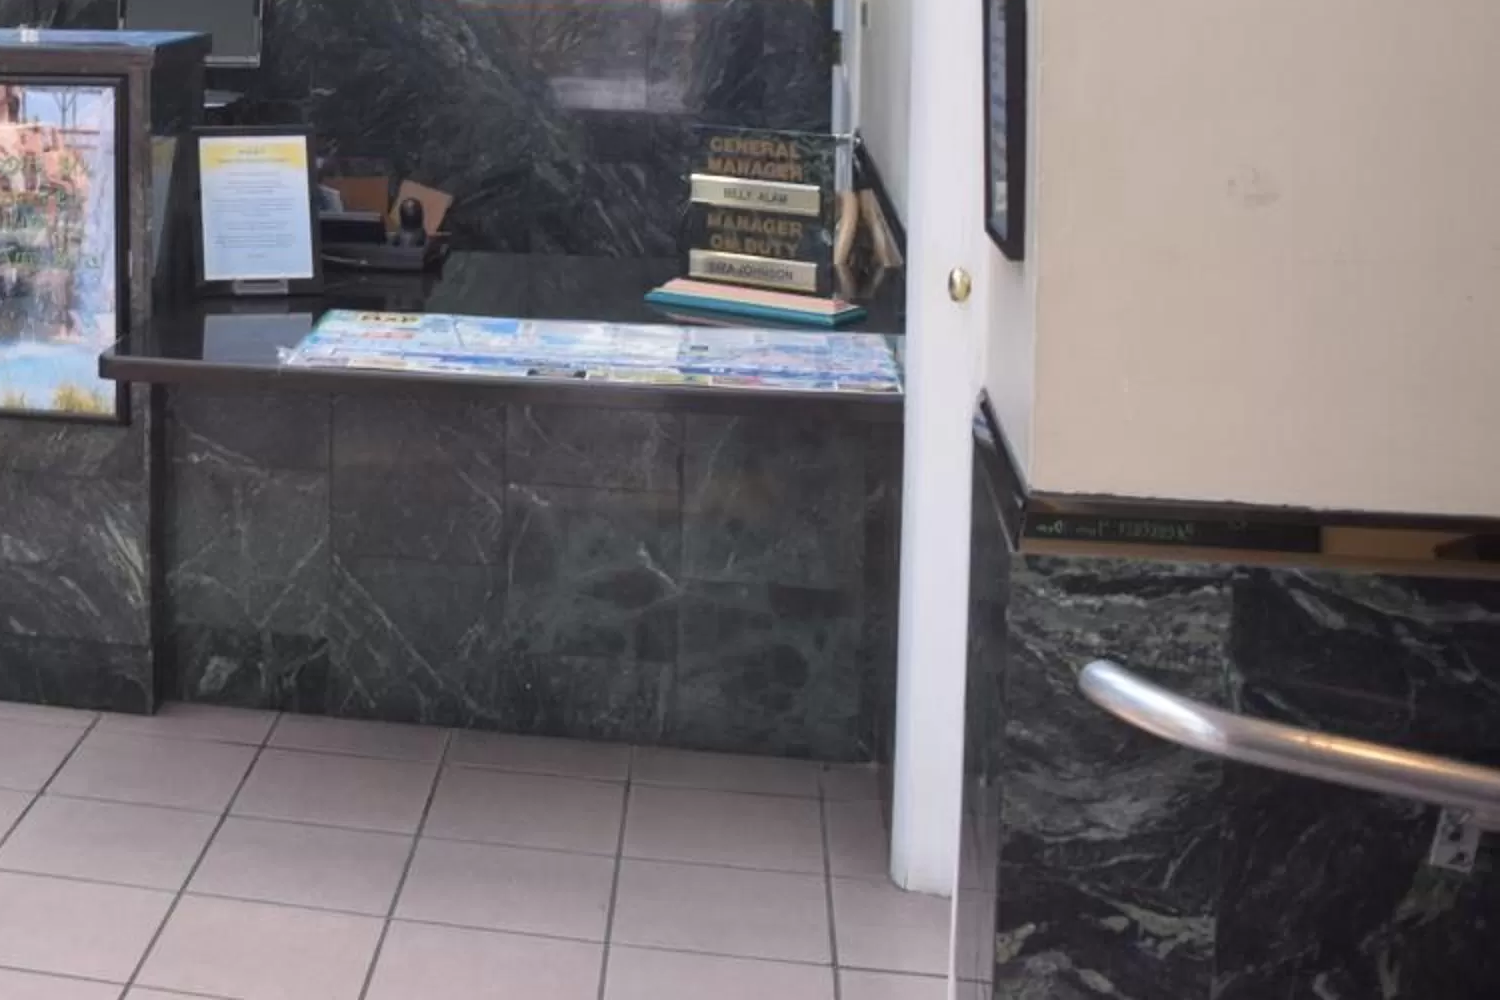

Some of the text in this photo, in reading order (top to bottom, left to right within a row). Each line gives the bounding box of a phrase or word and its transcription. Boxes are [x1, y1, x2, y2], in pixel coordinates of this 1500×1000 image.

[710, 136, 800, 160] GENERAL
[707, 157, 804, 181] MANAGER
[707, 212, 803, 238] MANAGER
